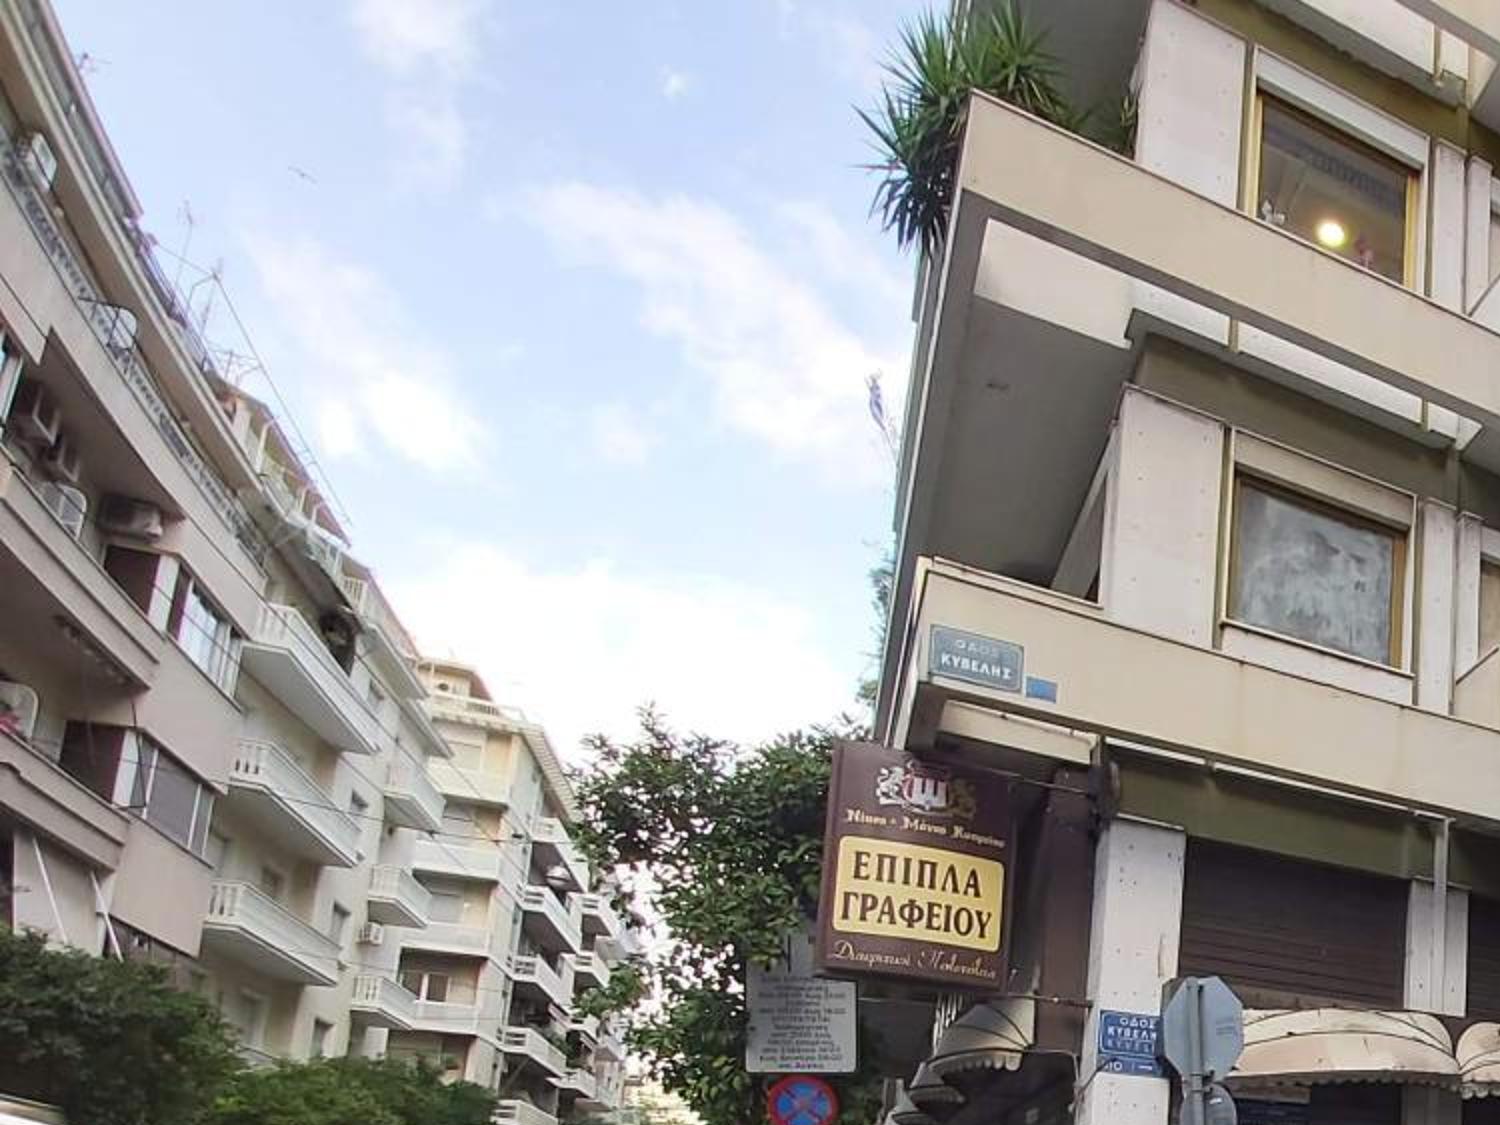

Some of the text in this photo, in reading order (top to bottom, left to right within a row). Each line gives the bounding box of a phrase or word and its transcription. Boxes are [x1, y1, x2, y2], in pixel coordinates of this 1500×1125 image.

[941, 652, 1012, 680] ΚΥΒΕΛΗΣ
[852, 850, 982, 899] ΕΠΙΠΛΑ
[840, 890, 993, 940] ΓΡΑΦΕΙΟΥ
[1107, 1025, 1157, 1041] ΚΥΒΕΛΗ
